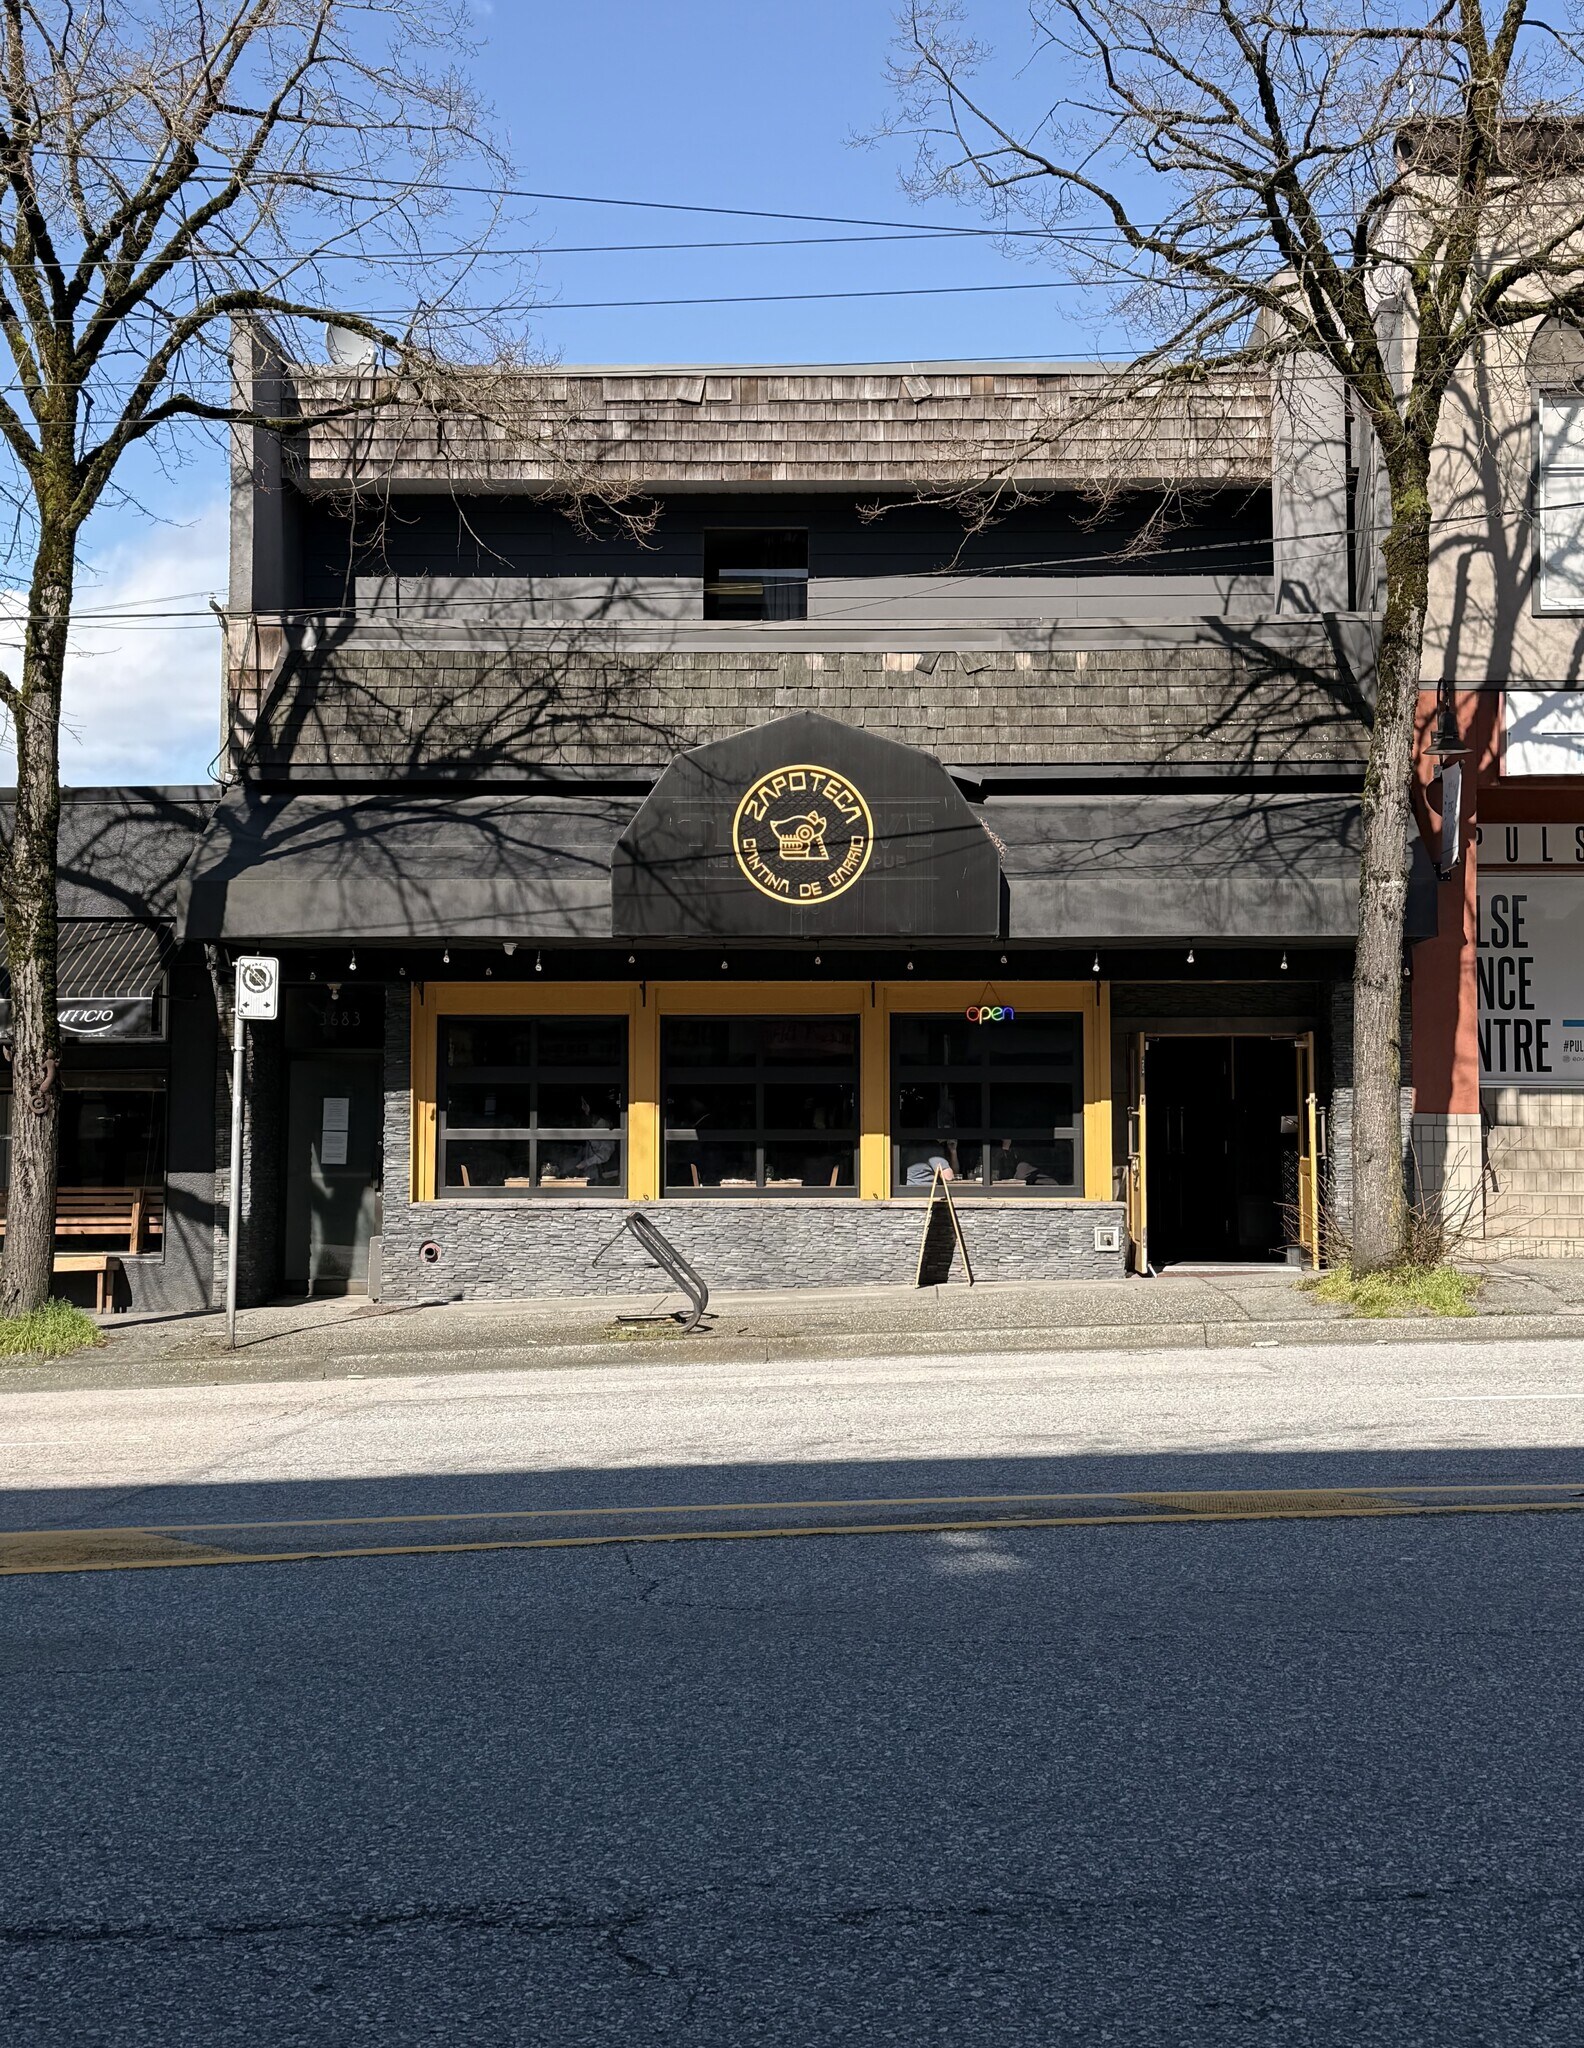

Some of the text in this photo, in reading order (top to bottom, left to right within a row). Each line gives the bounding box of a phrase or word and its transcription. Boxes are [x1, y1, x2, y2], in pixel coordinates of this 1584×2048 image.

[744, 771, 862, 825] ZAPOTECA
[742, 835, 865, 897] CANTINA DE BARRIO
[1477, 956, 1535, 1010] NCE
[319, 1011, 361, 1026] 3683
[966, 1006, 1015, 1025] open
[1478, 1019, 1552, 1073] NTRE
